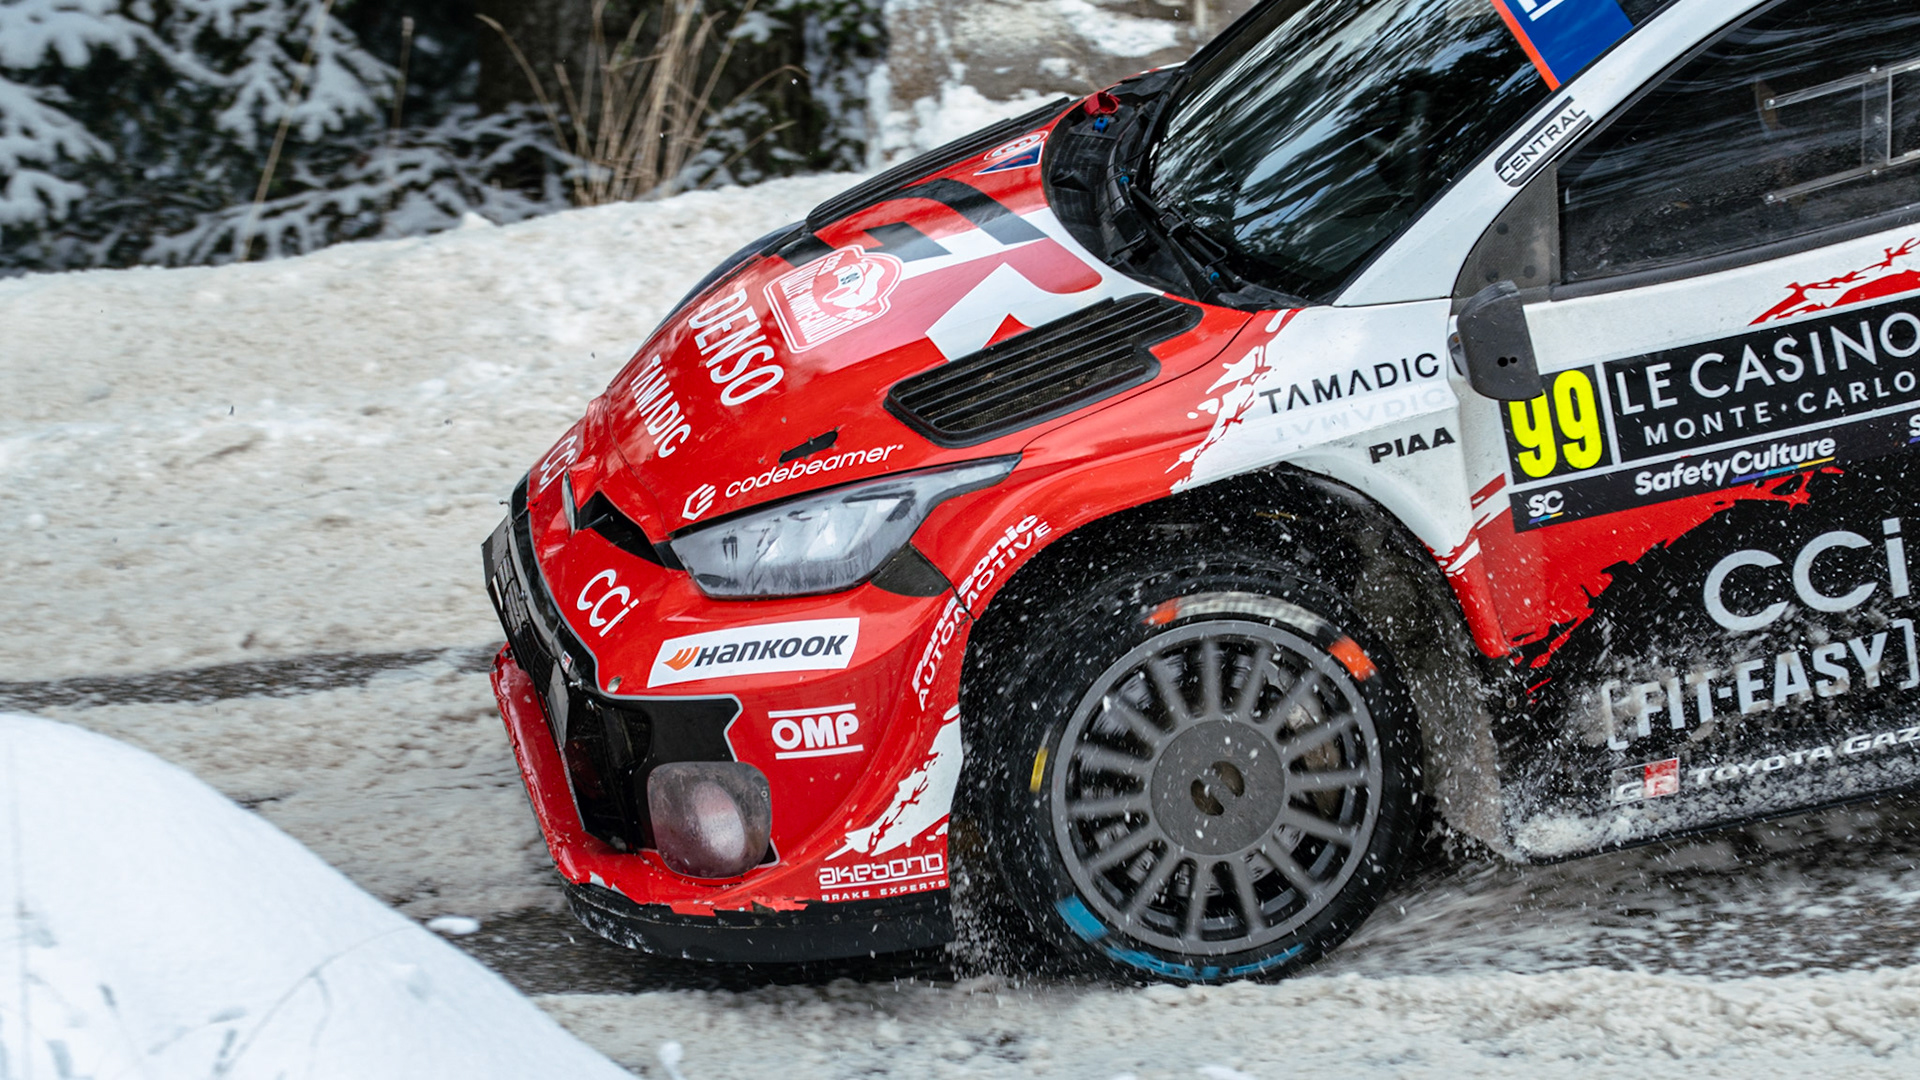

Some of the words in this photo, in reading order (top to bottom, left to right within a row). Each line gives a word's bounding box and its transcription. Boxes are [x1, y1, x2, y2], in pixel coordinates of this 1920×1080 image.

[1498, 107, 1586, 184] CENTRAL
[688, 287, 785, 407] DENSO
[1614, 362, 1679, 417] LE
[1689, 312, 1920, 399] CASINO
[630, 353, 692, 459] TAMADIC
[1258, 352, 1440, 415] TAMADIC
[1368, 427, 1456, 464] PIAA
[1508, 369, 1603, 478] 99
[725, 446, 904, 499] codebeamer
[1634, 437, 1837, 496] SafetyCulture
[1528, 489, 1564, 518] SC
[912, 514, 1038, 694] Panasonic
[918, 520, 1052, 712] AUTOMOTIVE
[770, 711, 860, 751] OMP
[1687, 745, 1835, 786] TOYOTA
[819, 853, 944, 885] akebono
[821, 890, 870, 902] BRAKE
[879, 879, 947, 896] EXPERTS
